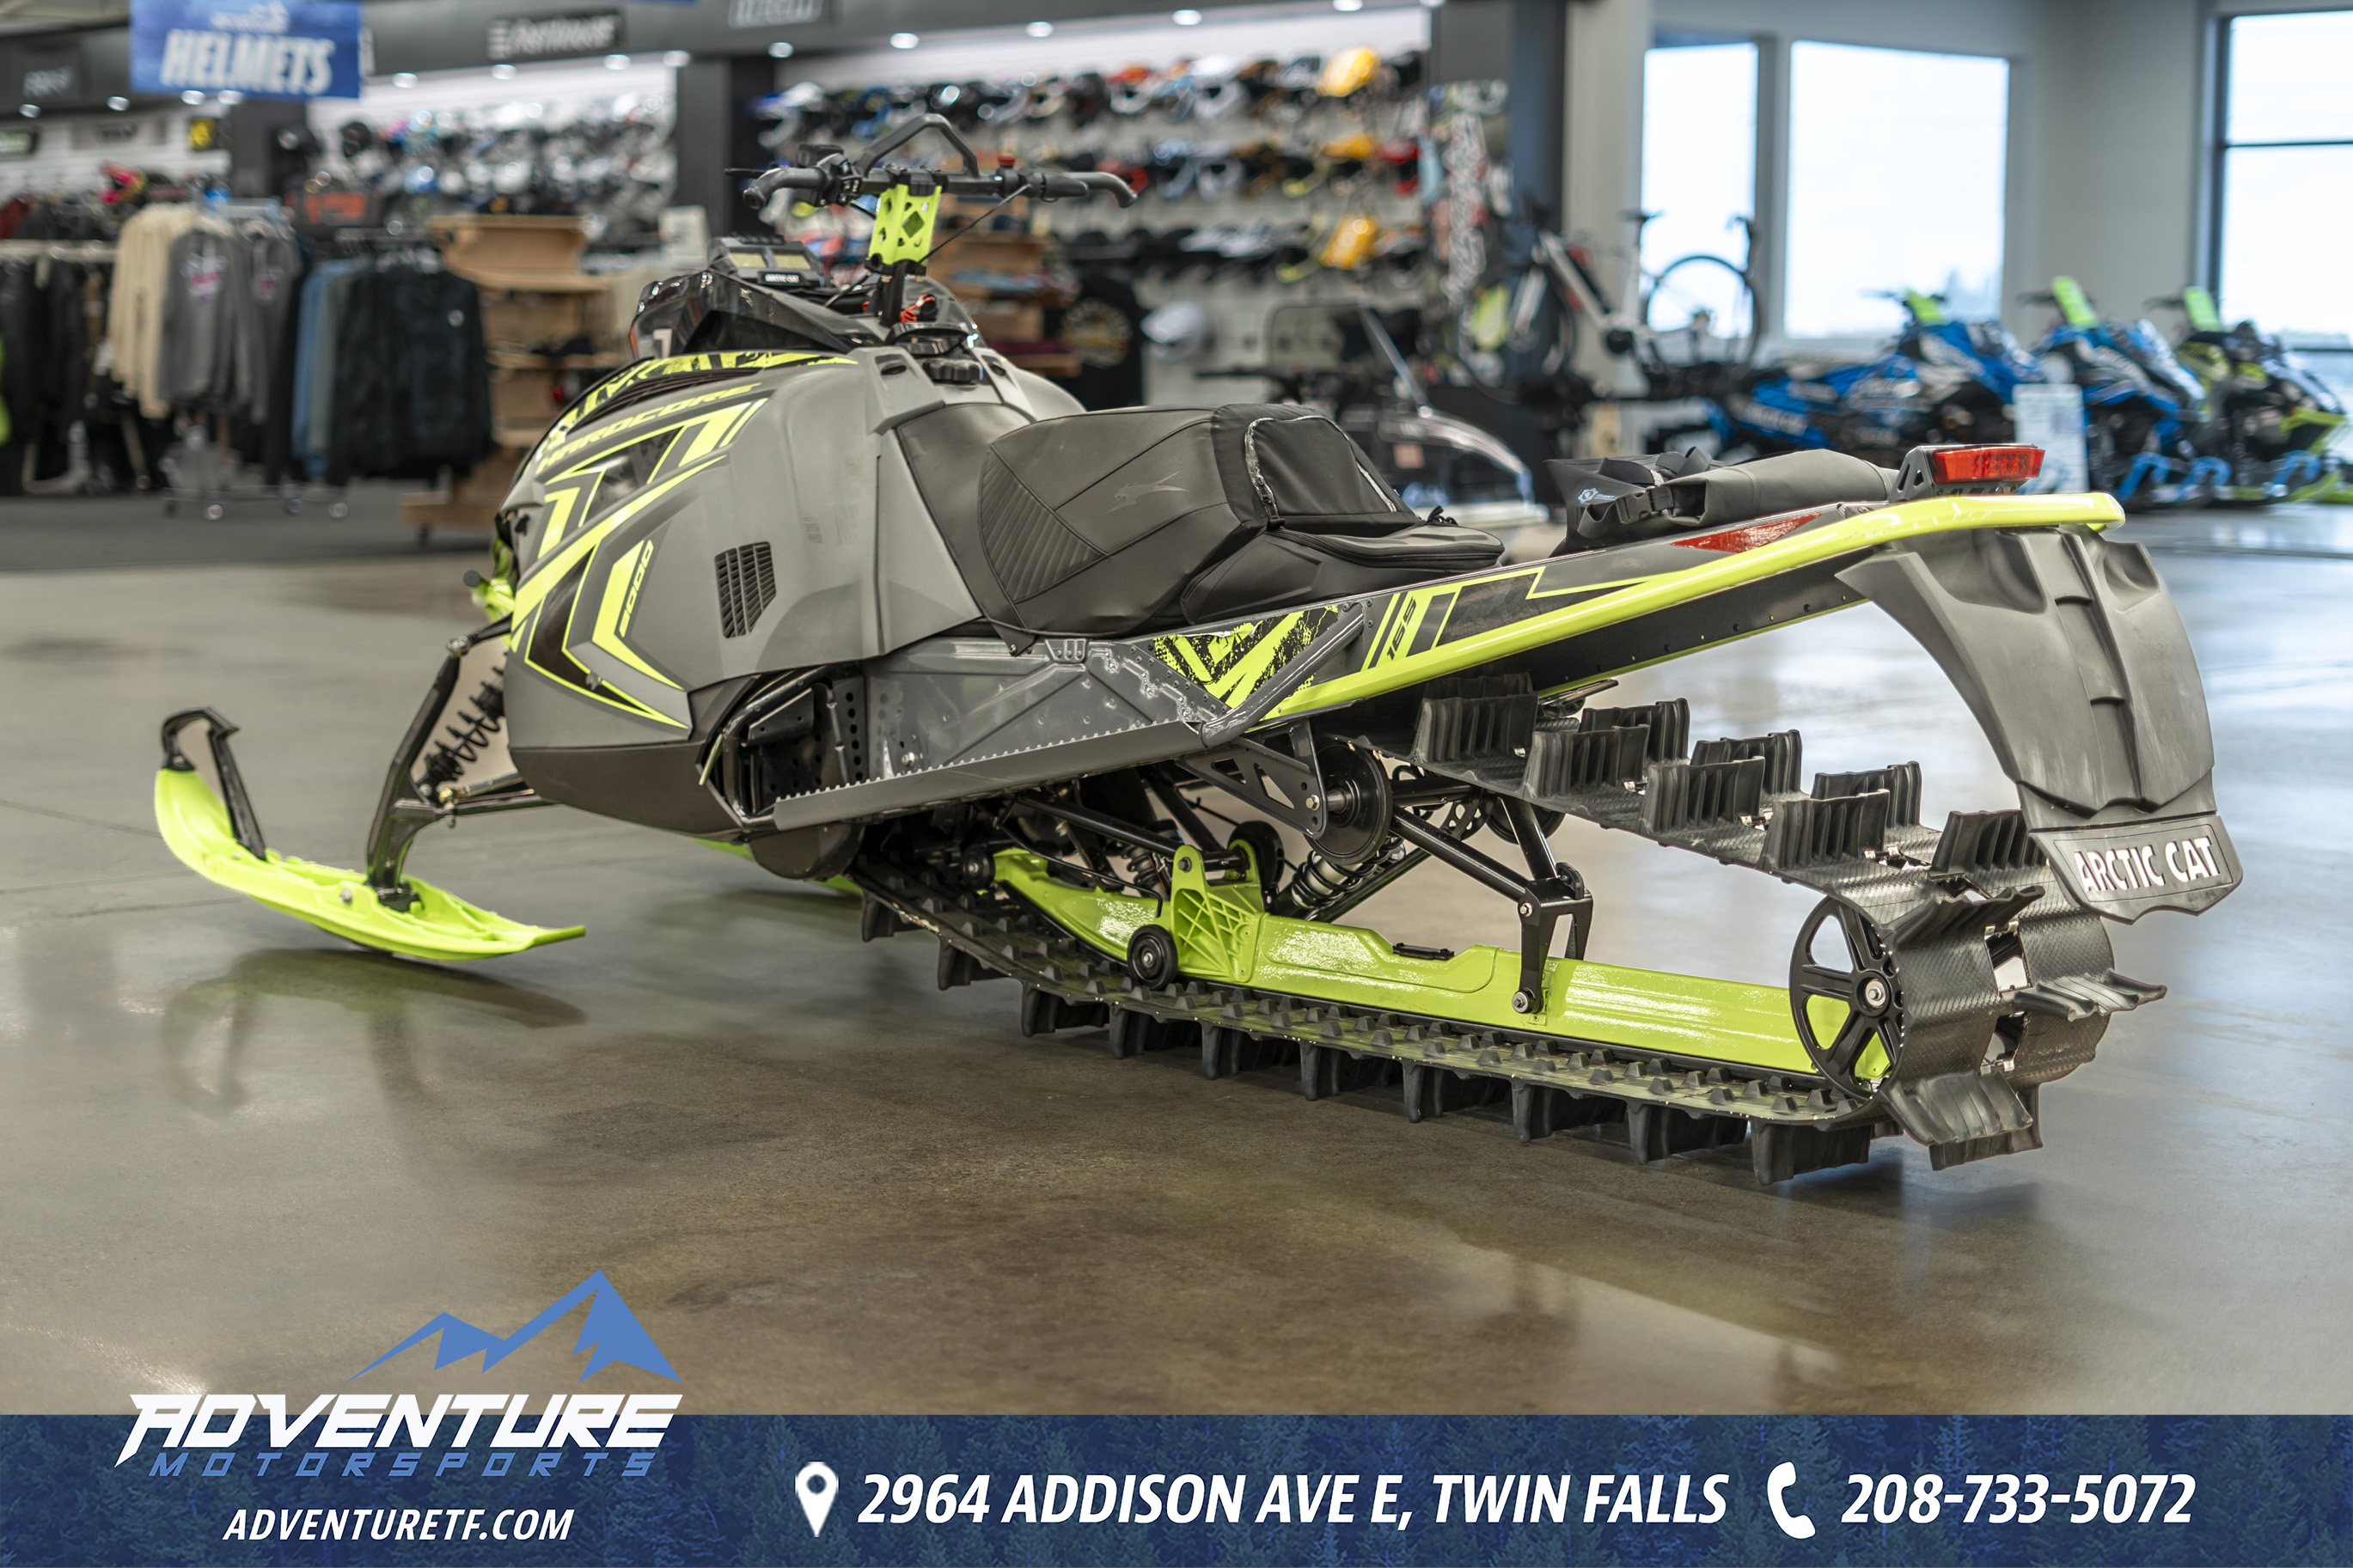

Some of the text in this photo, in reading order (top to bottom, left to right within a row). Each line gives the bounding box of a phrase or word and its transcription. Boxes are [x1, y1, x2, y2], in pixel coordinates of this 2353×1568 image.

[160, 28, 336, 95] HELMETS
[535, 382, 761, 475] HARDCORE
[1387, 595, 1416, 661] 165
[2074, 836, 2221, 893] ARCTIC CAT
